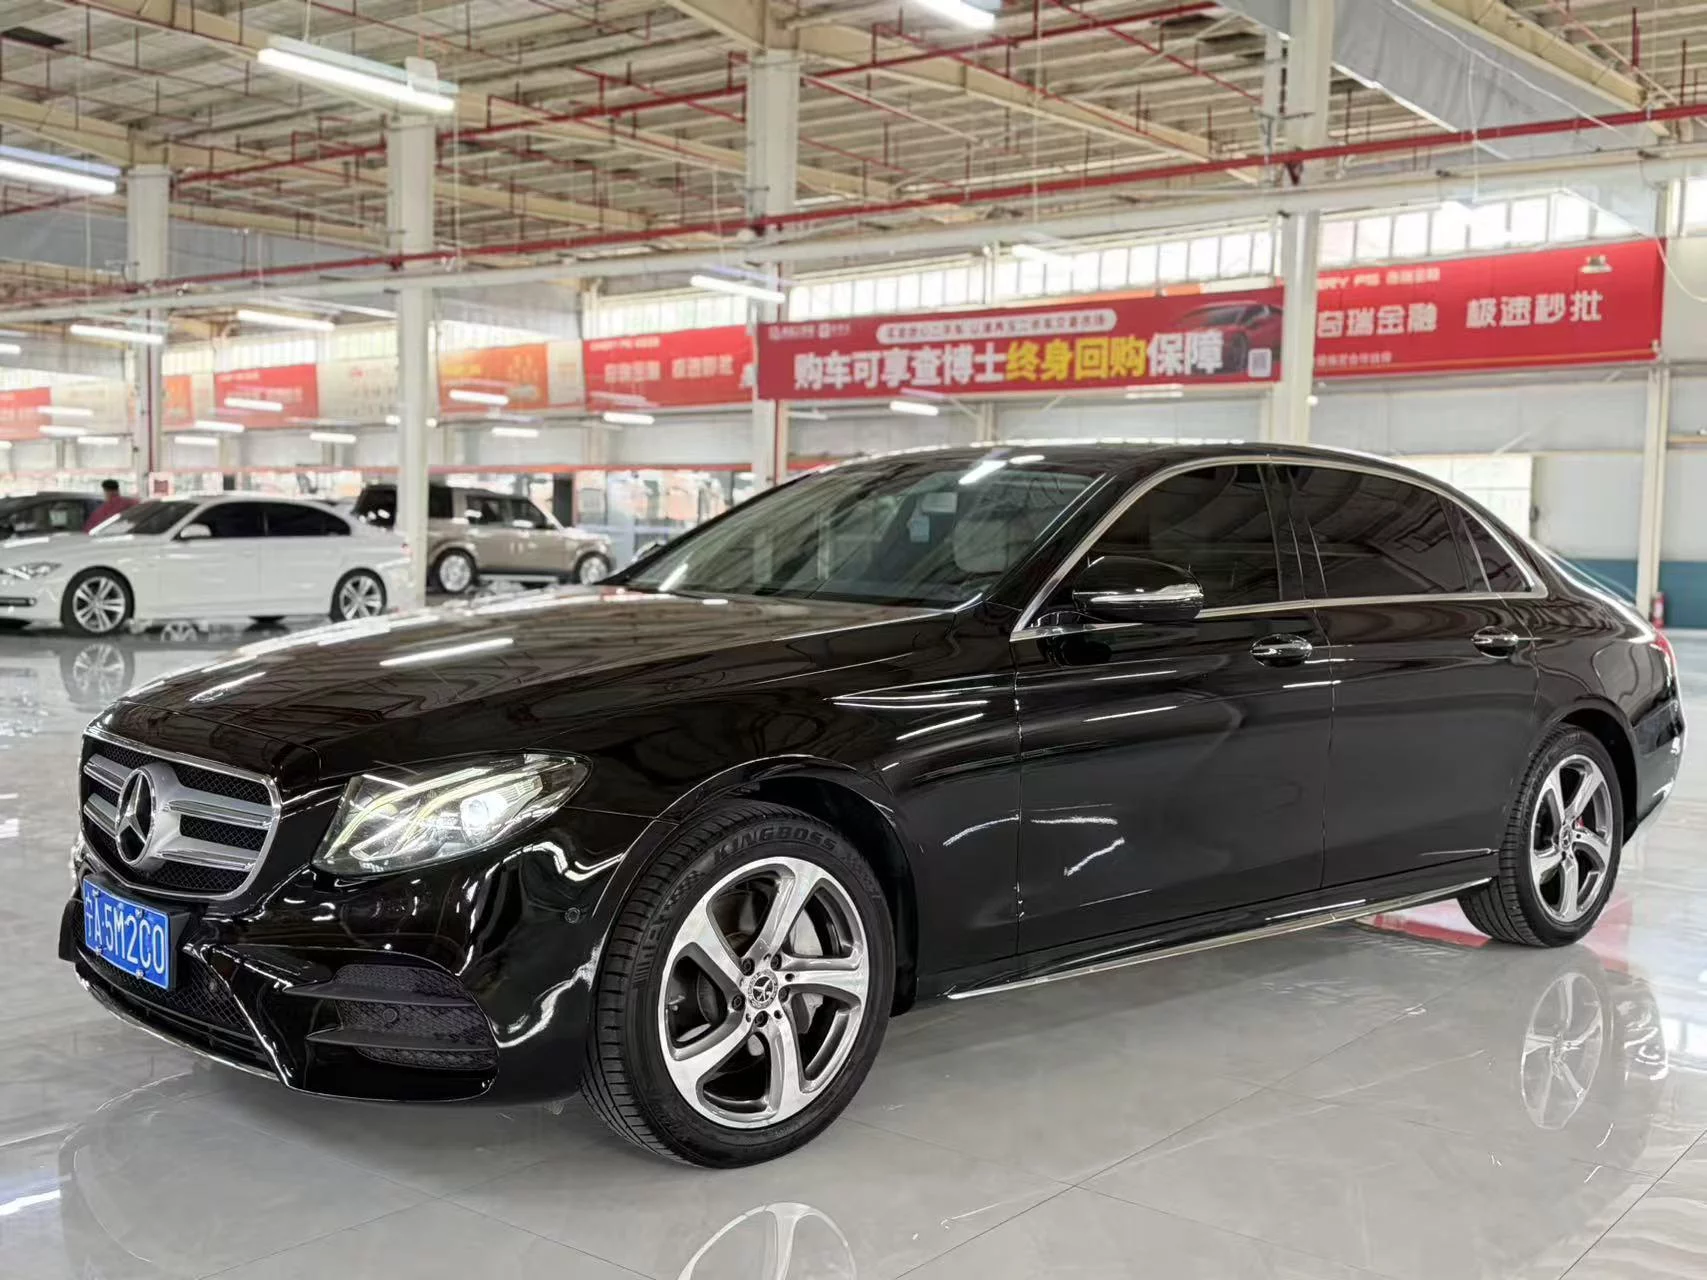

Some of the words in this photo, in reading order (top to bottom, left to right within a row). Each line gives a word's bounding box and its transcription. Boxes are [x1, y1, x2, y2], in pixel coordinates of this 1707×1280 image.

[1317, 303, 1437, 338] 奇瑞金融
[1466, 290, 1603, 329] 极速秒批
[794, 329, 1224, 391] 购车可享查博士终身回购保障
[717, 826, 837, 860] KINGBOSS
